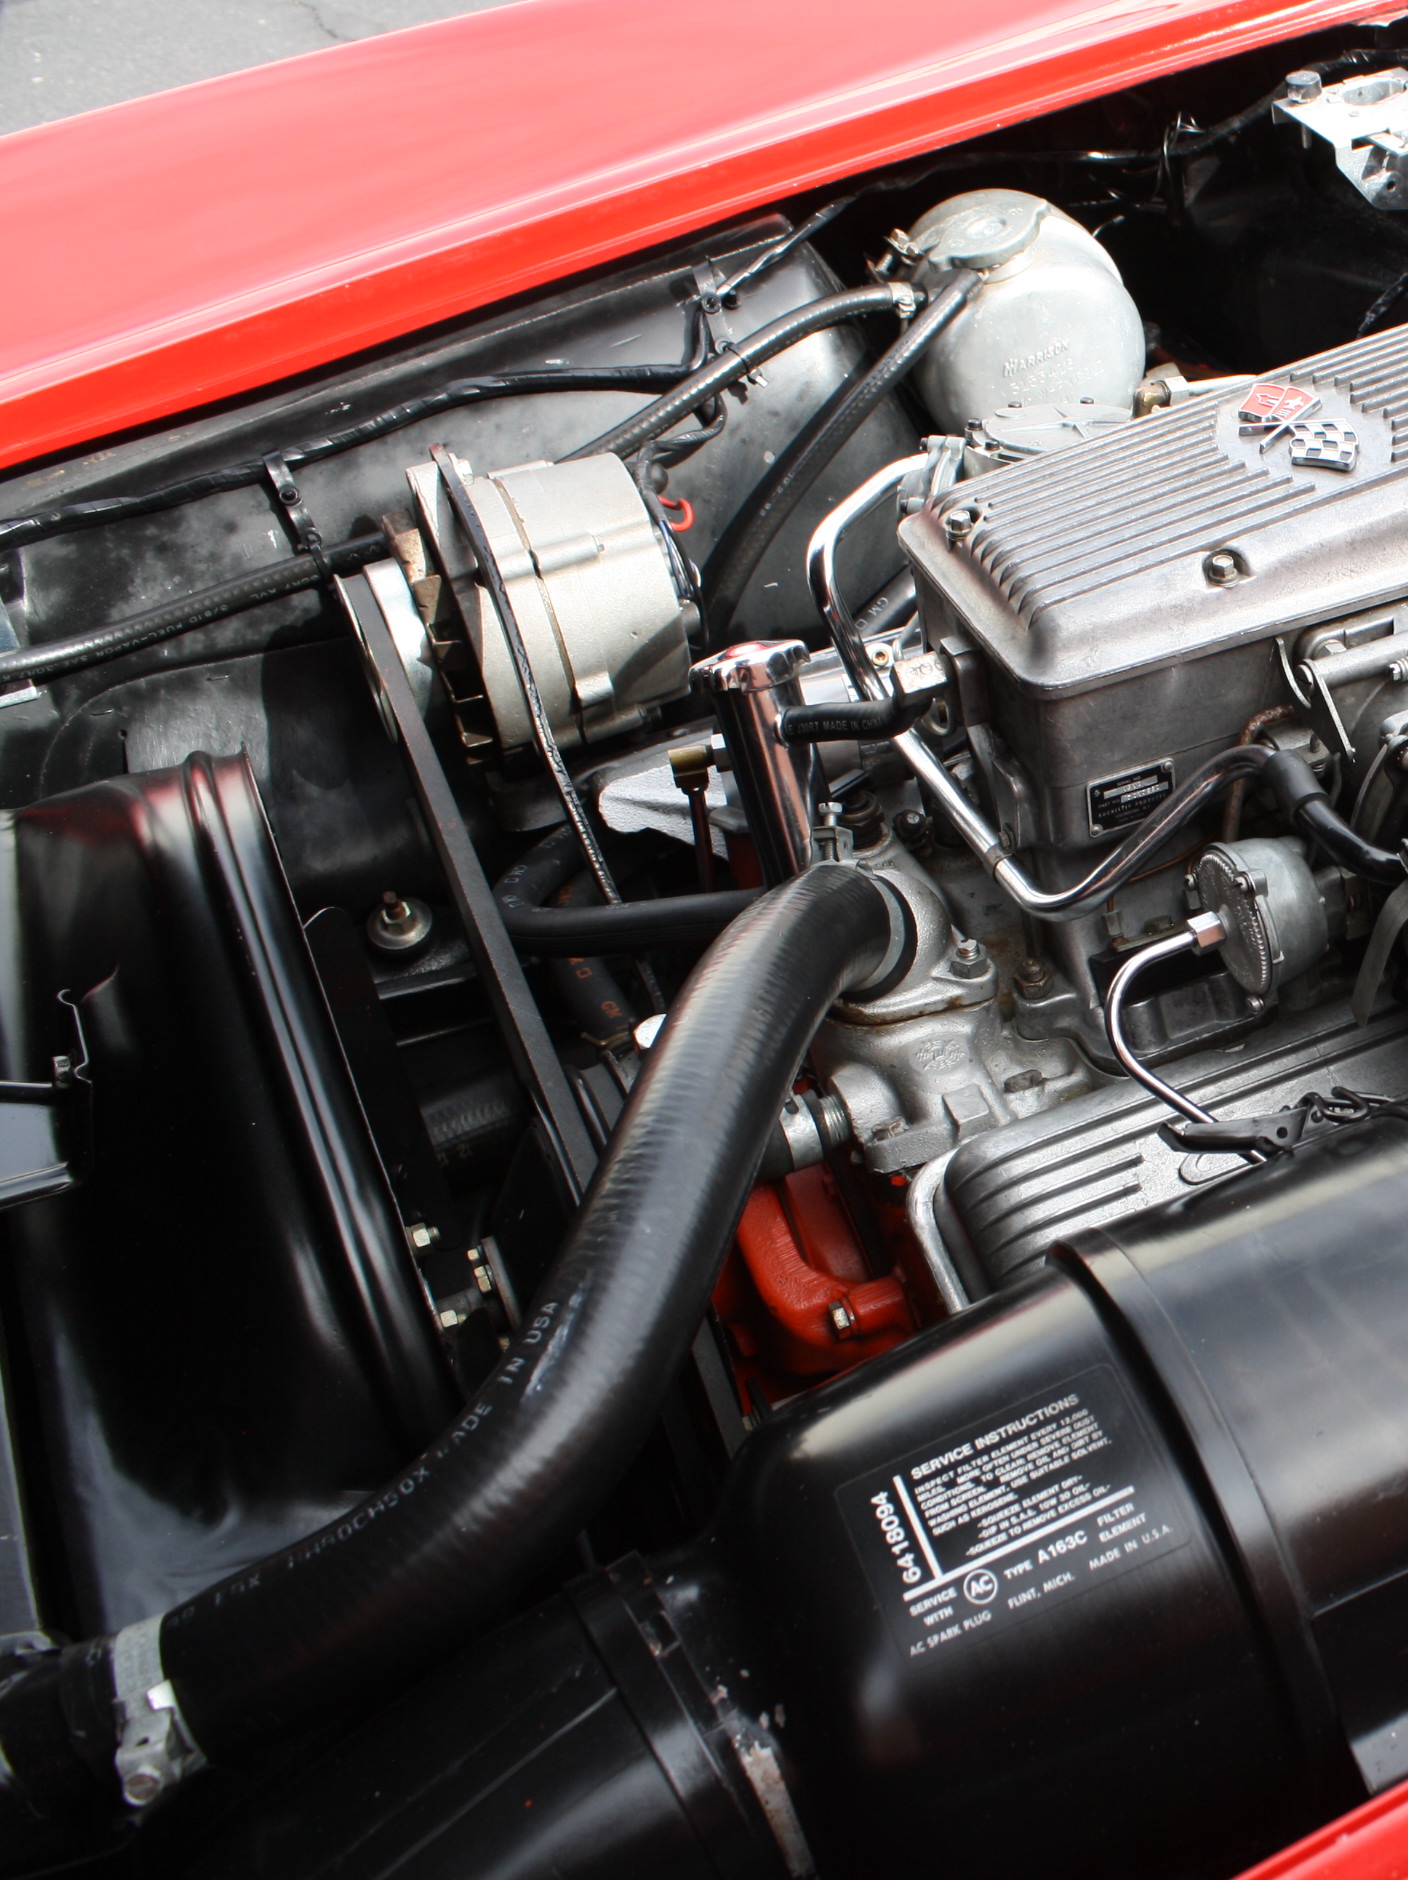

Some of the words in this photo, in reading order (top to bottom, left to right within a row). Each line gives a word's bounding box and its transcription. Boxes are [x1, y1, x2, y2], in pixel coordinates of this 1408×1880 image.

[1003, 338, 1068, 377] HARRISON
[822, 719, 847, 732] MADE
[850, 719, 859, 730] IN
[498, 1355, 526, 1386] IN
[524, 1301, 559, 1345] USA
[911, 1443, 974, 1480] SERVICE
[974, 1393, 1079, 1450] INSTRUCTIONS
[914, 1470, 955, 1495] INSPECT
[957, 1454, 990, 1475] FILTER
[991, 1435, 1029, 1459] ELEMENT
[1030, 1422, 1057, 1440] EVERY
[956, 1468, 981, 1485] MORE
[982, 1454, 1010, 1472] OFTEN
[1010, 1441, 1039, 1459] UNDER
[1040, 1425, 1072, 1445] SEVERE
[1073, 1415, 1095, 1430] DUST
[980, 1472, 994, 1482] TO
[1027, 1441, 1061, 1461] REMOVE
[1061, 1422, 1098, 1445] ELEMENT
[924, 1501, 950, 1519] FROM
[1000, 1461, 1035, 1483] REMOVE
[1052, 1446, 1070, 1459] AND
[1070, 1435, 1090, 1450] DIRT
[1091, 1430, 1103, 1440] BY
[927, 1503, 968, 1527] WASHING
[968, 1484, 1010, 1509] ELEMENT.
[1010, 1474, 1029, 1489] USE
[1029, 1455, 1071, 1480] SUITABLE
[1021, 1483, 1060, 1509] ELEMENT
[870, 1491, 922, 1584] 6418094
[932, 1520, 957, 1537] SUCH
[957, 1512, 970, 1525] AS
[999, 1519, 1010, 1531] IN
[1008, 1525, 1022, 1537] TO
[1021, 1508, 1058, 1531] REMOVE
[1057, 1491, 1092, 1514] EXCESS
[1097, 1502, 1135, 1527] FILTER
[1098, 1512, 1146, 1543] ELEMENT
[910, 1641, 926, 1657] AC
[926, 1624, 962, 1649] SPARK
[963, 1610, 992, 1632] PLUG
[1007, 1587, 1042, 1610] FLINT,
[1042, 1571, 1076, 1593] MICH.
[1088, 1547, 1121, 1571] MADE
[1123, 1540, 1138, 1553] IN
[1141, 1524, 1174, 1545] U.S.A.
[969, 1574, 994, 1598] AC
[1003, 1559, 1034, 1580] TYPE
[1037, 1530, 1088, 1564] A163C
[909, 1586, 958, 1617] SERVICE
[923, 1605, 954, 1626] WITH
